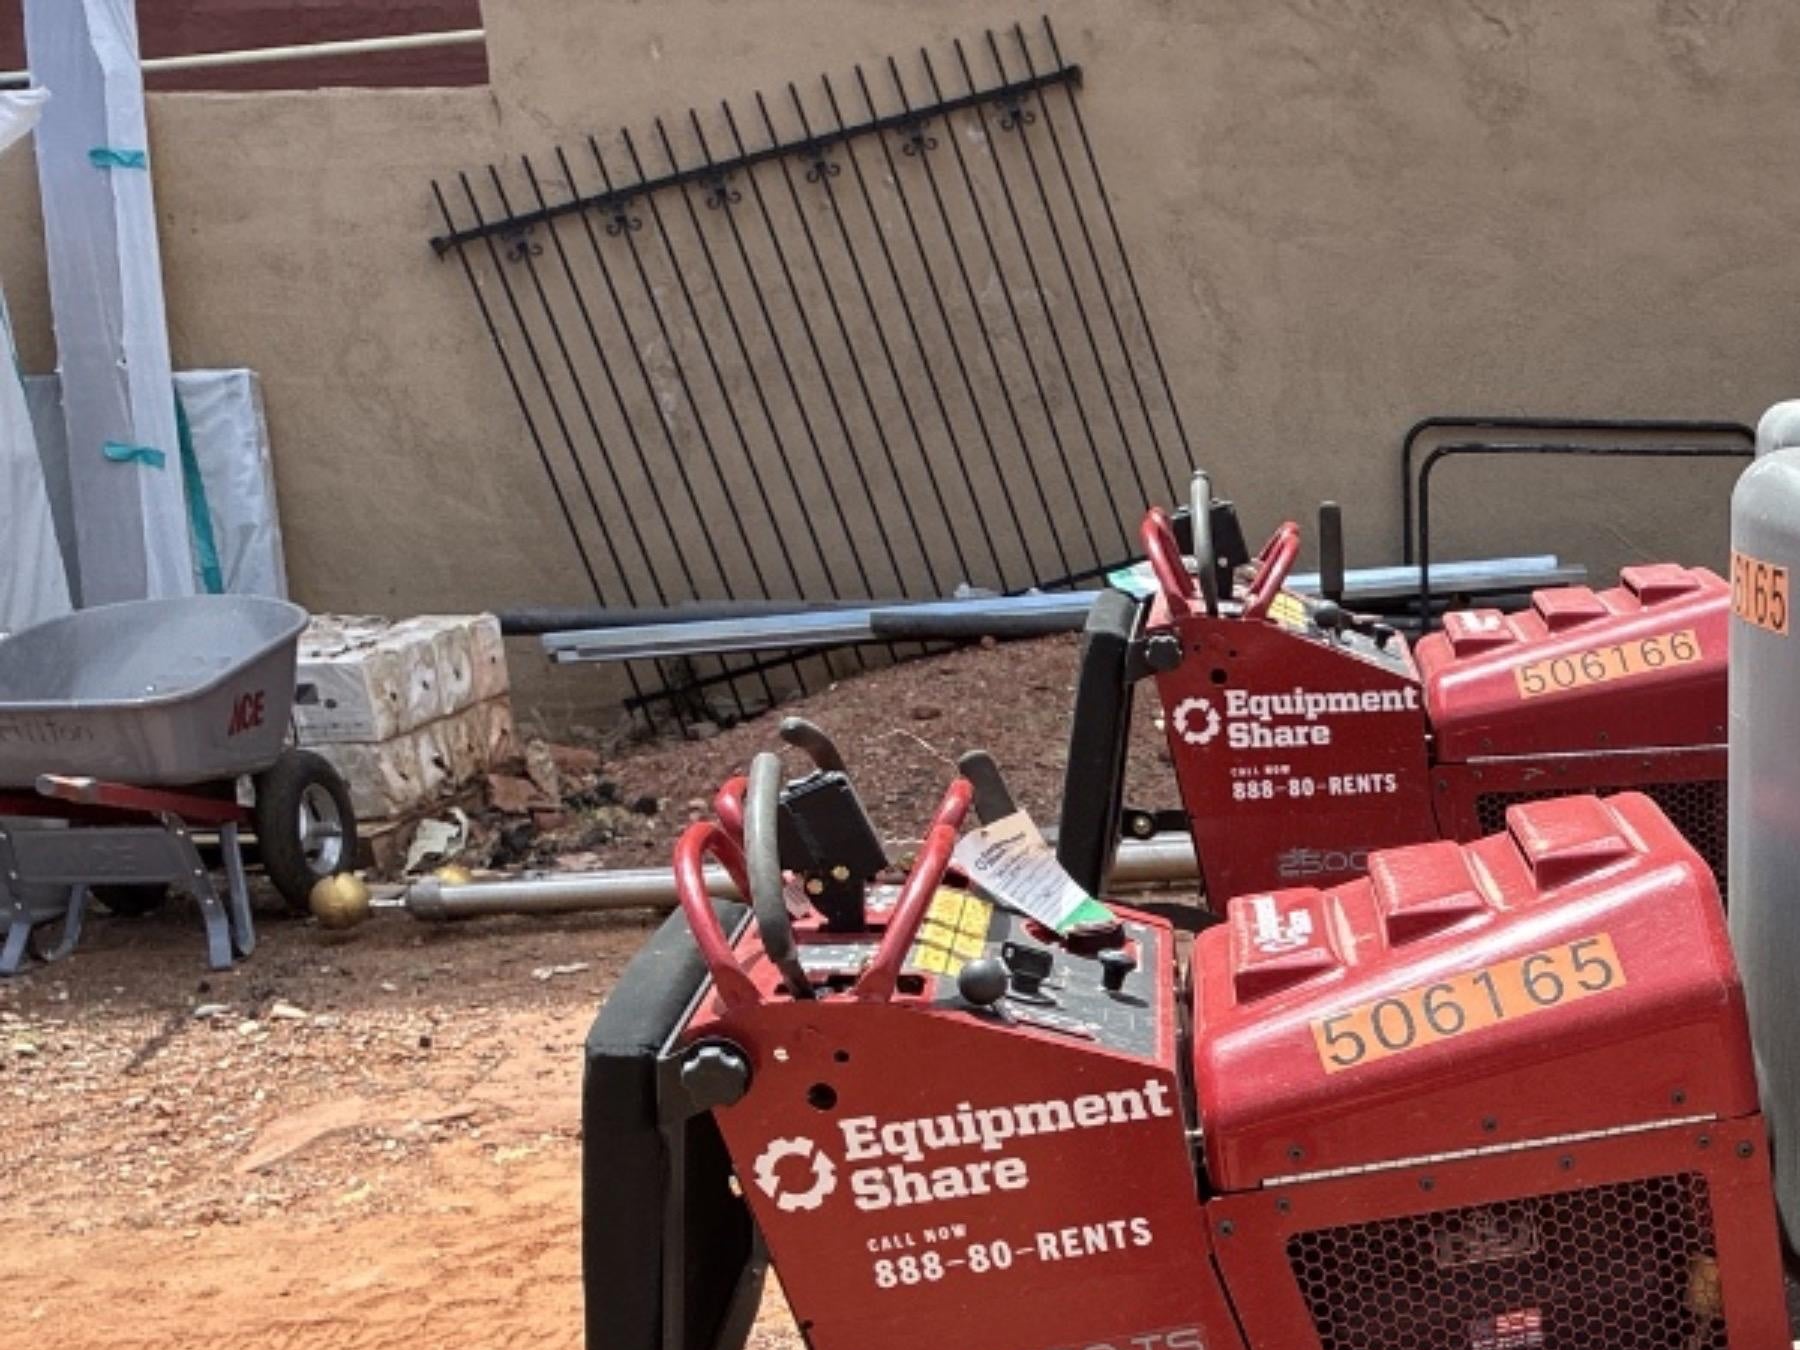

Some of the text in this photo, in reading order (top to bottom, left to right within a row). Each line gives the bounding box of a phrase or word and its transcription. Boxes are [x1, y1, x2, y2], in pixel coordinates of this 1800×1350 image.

[1521, 632, 1695, 693] 506166
[1224, 686, 1419, 721] Equipment
[1227, 722, 1331, 748] Share
[1232, 773, 1397, 800] 888-80-RENTS
[1322, 938, 1617, 1068] 506165
[837, 1078, 1172, 1162] Equipment
[850, 1156, 1029, 1211] Share
[866, 1223, 968, 1252] CALL NOW
[874, 1216, 1154, 1288] 888-80-RENTS
